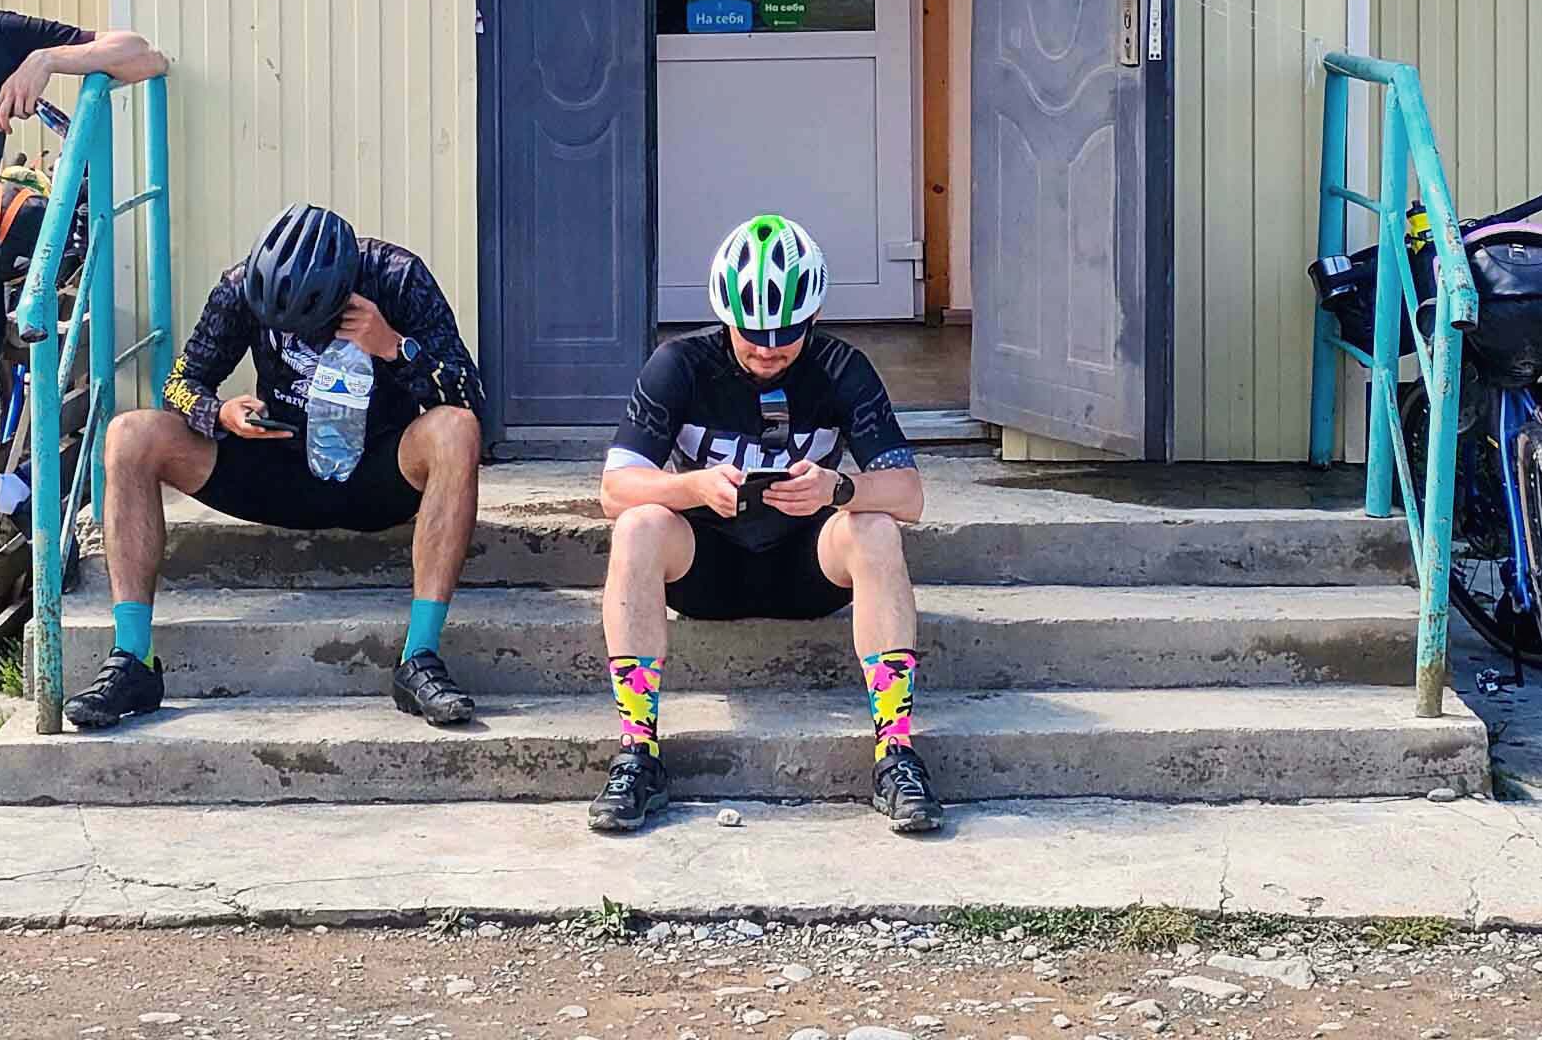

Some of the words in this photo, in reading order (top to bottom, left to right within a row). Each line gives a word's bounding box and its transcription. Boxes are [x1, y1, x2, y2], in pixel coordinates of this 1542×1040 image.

[765, 4, 779, 12] На
[780, 3, 805, 12] себя
[696, 13, 712, 24] На
[715, 12, 744, 24] себя
